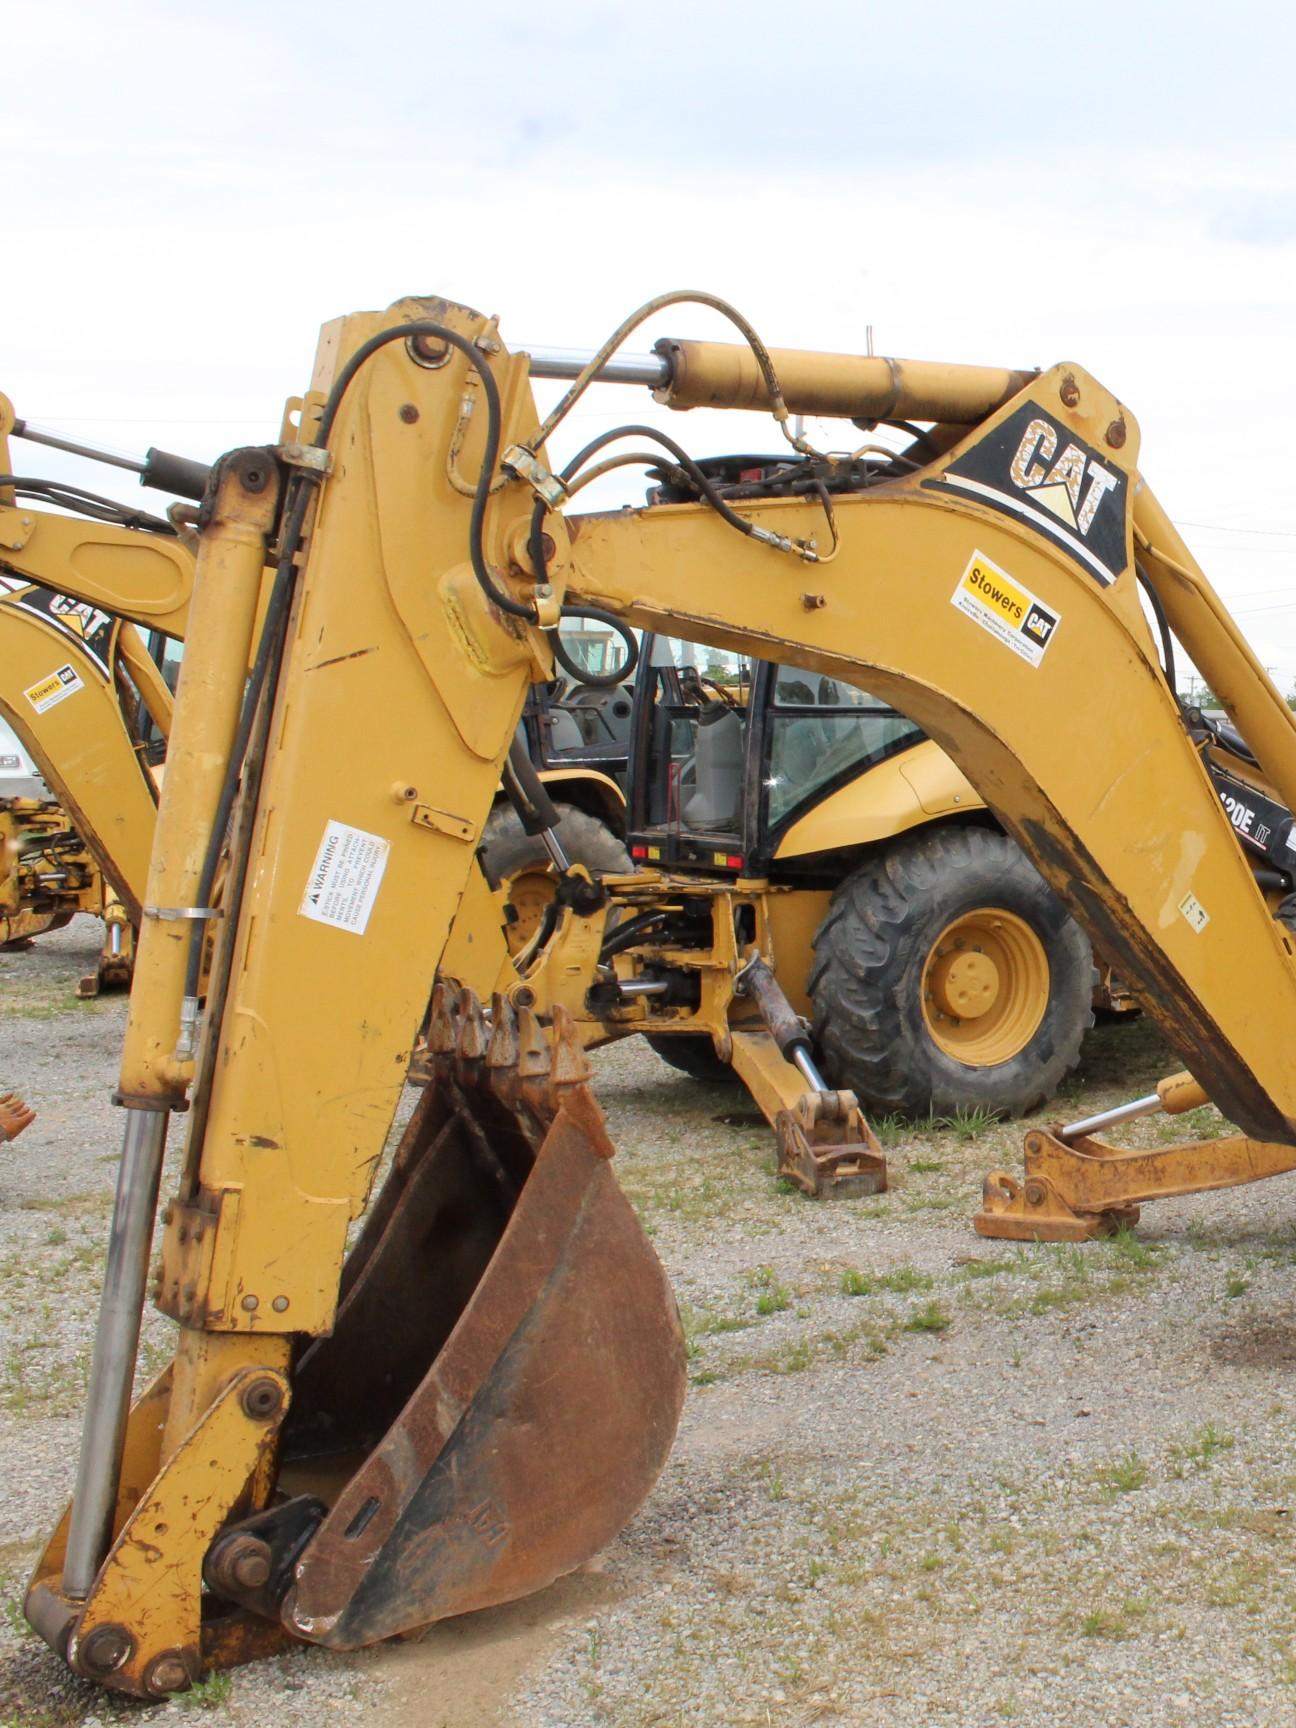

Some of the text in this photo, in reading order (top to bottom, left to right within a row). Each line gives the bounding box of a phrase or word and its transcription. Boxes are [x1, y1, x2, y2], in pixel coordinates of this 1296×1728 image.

[1010, 419, 1117, 536] CAT
[49, 594, 111, 640] CAT
[969, 568, 1022, 620] Stowers
[1027, 611, 1052, 639] CAT
[30, 679, 60, 701] Stowers
[313, 835, 339, 890] WARNING
